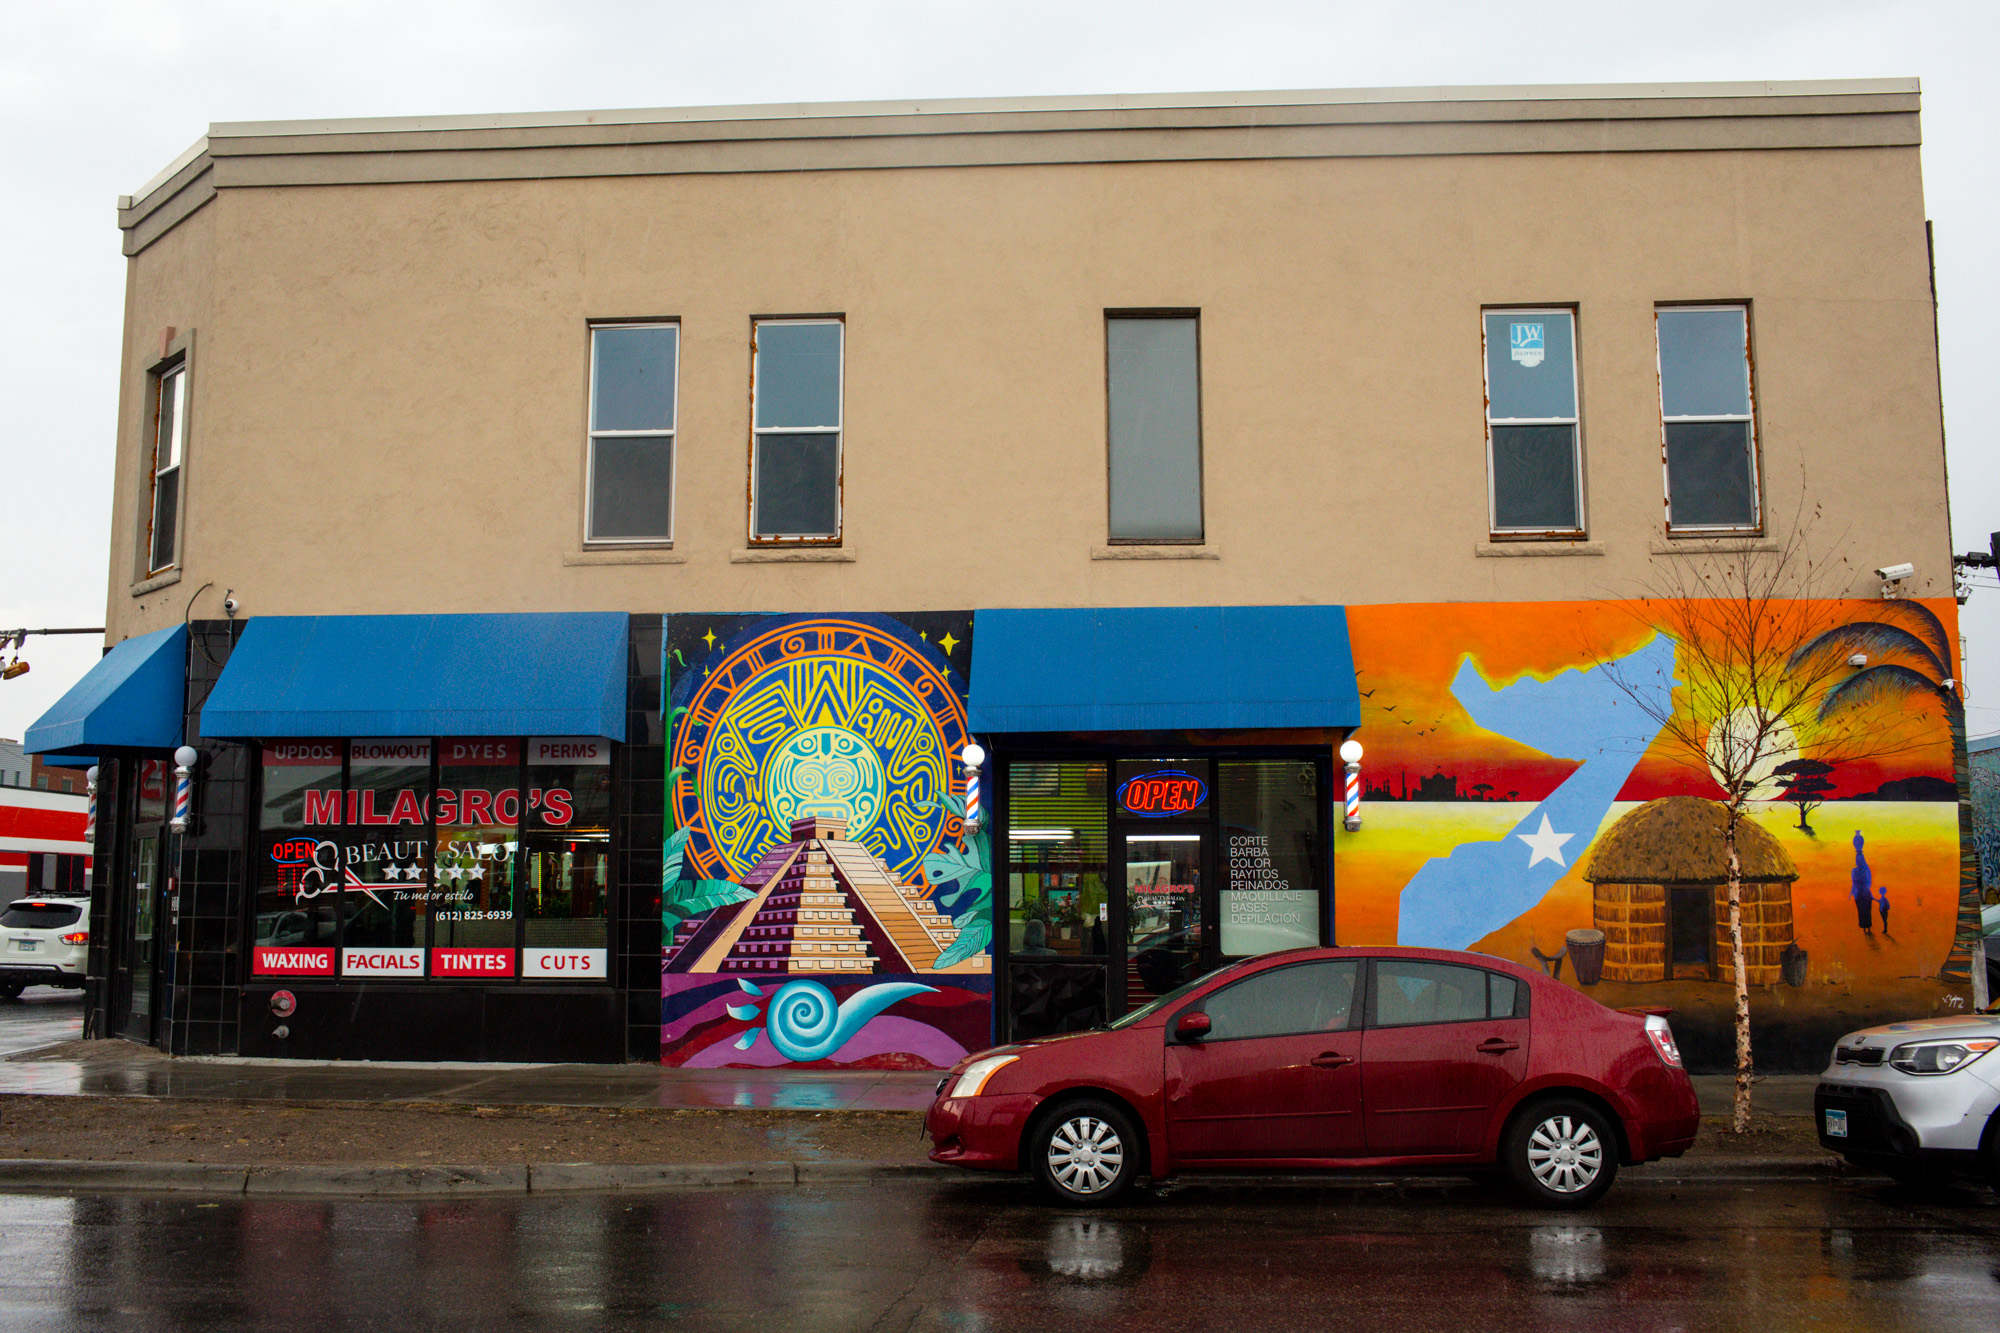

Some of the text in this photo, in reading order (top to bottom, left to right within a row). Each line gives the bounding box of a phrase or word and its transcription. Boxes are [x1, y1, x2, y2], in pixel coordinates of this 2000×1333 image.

[1512, 325, 1541, 344] JW
[274, 745, 333, 760] UPDOS
[351, 744, 431, 759] BLOWOUT
[453, 744, 507, 760] DYES
[539, 743, 598, 759] PERMS
[1126, 780, 1199, 810] OPEN
[304, 788, 574, 826] MILAGRO'S
[1229, 836, 1268, 847] CORTE
[273, 842, 315, 860] OPEN
[1230, 847, 1269, 857] BARBA
[1230, 858, 1271, 869] COLOR
[1230, 868, 1279, 879] RAYITOS
[1134, 884, 1195, 894] MILAGRO'S
[1230, 880, 1289, 890] PEINADOS
[393, 890, 410, 901] Tu
[444, 889, 474, 901] estilo
[1231, 891, 1303, 902] MAQUILLAJE
[1231, 902, 1268, 913] BASES
[435, 910, 513, 922] (612) 825-6939
[1231, 913, 1301, 924] DEPILACION
[262, 953, 328, 969] WAXING
[347, 954, 420, 969] FACIALS
[441, 954, 507, 970] TINTES
[540, 955, 591, 970] CUTS
